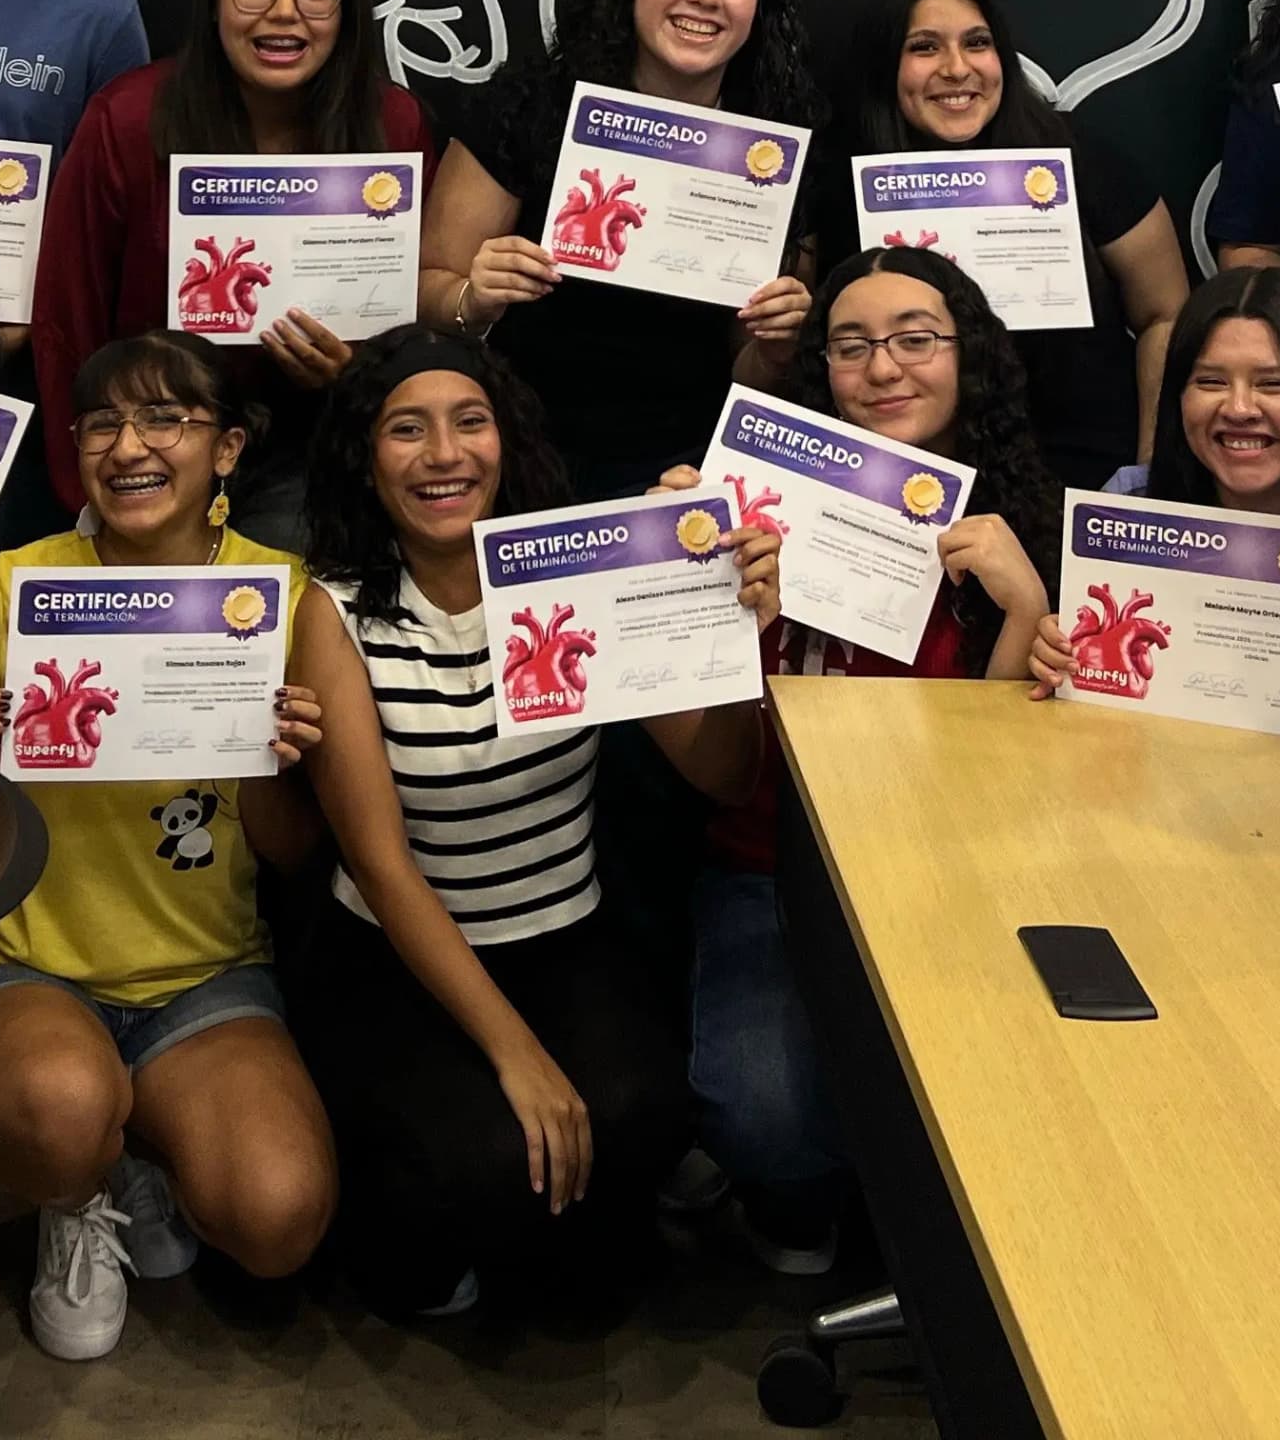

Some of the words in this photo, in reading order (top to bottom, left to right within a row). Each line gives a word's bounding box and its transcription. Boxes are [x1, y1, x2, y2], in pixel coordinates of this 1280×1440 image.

[588, 109, 707, 145] CERTIFICADO
[586, 126, 600, 137] DE
[603, 130, 673, 150] TERMINACIÓN
[191, 178, 319, 194] CERTIFICADO
[873, 171, 986, 191] CERTIFICADO
[193, 196, 207, 205] DE
[211, 194, 285, 205] TERMINACIÓN
[876, 193, 889, 202] DE
[892, 189, 959, 201] TERMINACIÓN
[552, 240, 604, 260] Superfy
[180, 311, 234, 325] Superfy
[737, 431, 751, 443] DE
[753, 436, 826, 470] TERMINACIÓN
[740, 414, 863, 470] CERTIFICADO
[497, 525, 629, 562] CERTIFICADO
[1086, 517, 1227, 550] CERTIFICADO
[1087, 537, 1103, 548] DE
[1107, 540, 1189, 559] TERMINACIÓN
[502, 563, 516, 575] DE
[520, 549, 598, 572] TERMINACIÓN
[33, 592, 174, 610] CERTIFICADO
[616, 596, 636, 604] Alexa
[664, 584, 702, 596] Hernández
[34, 613, 50, 623] DE
[55, 611, 137, 622] TERMINACIÓN
[1205, 602, 1235, 612] Melanie
[1236, 606, 1261, 616] Mayte
[1078, 666, 1128, 687] uperfy
[507, 690, 565, 710] Superfy
[15, 743, 76, 759] Superfy
